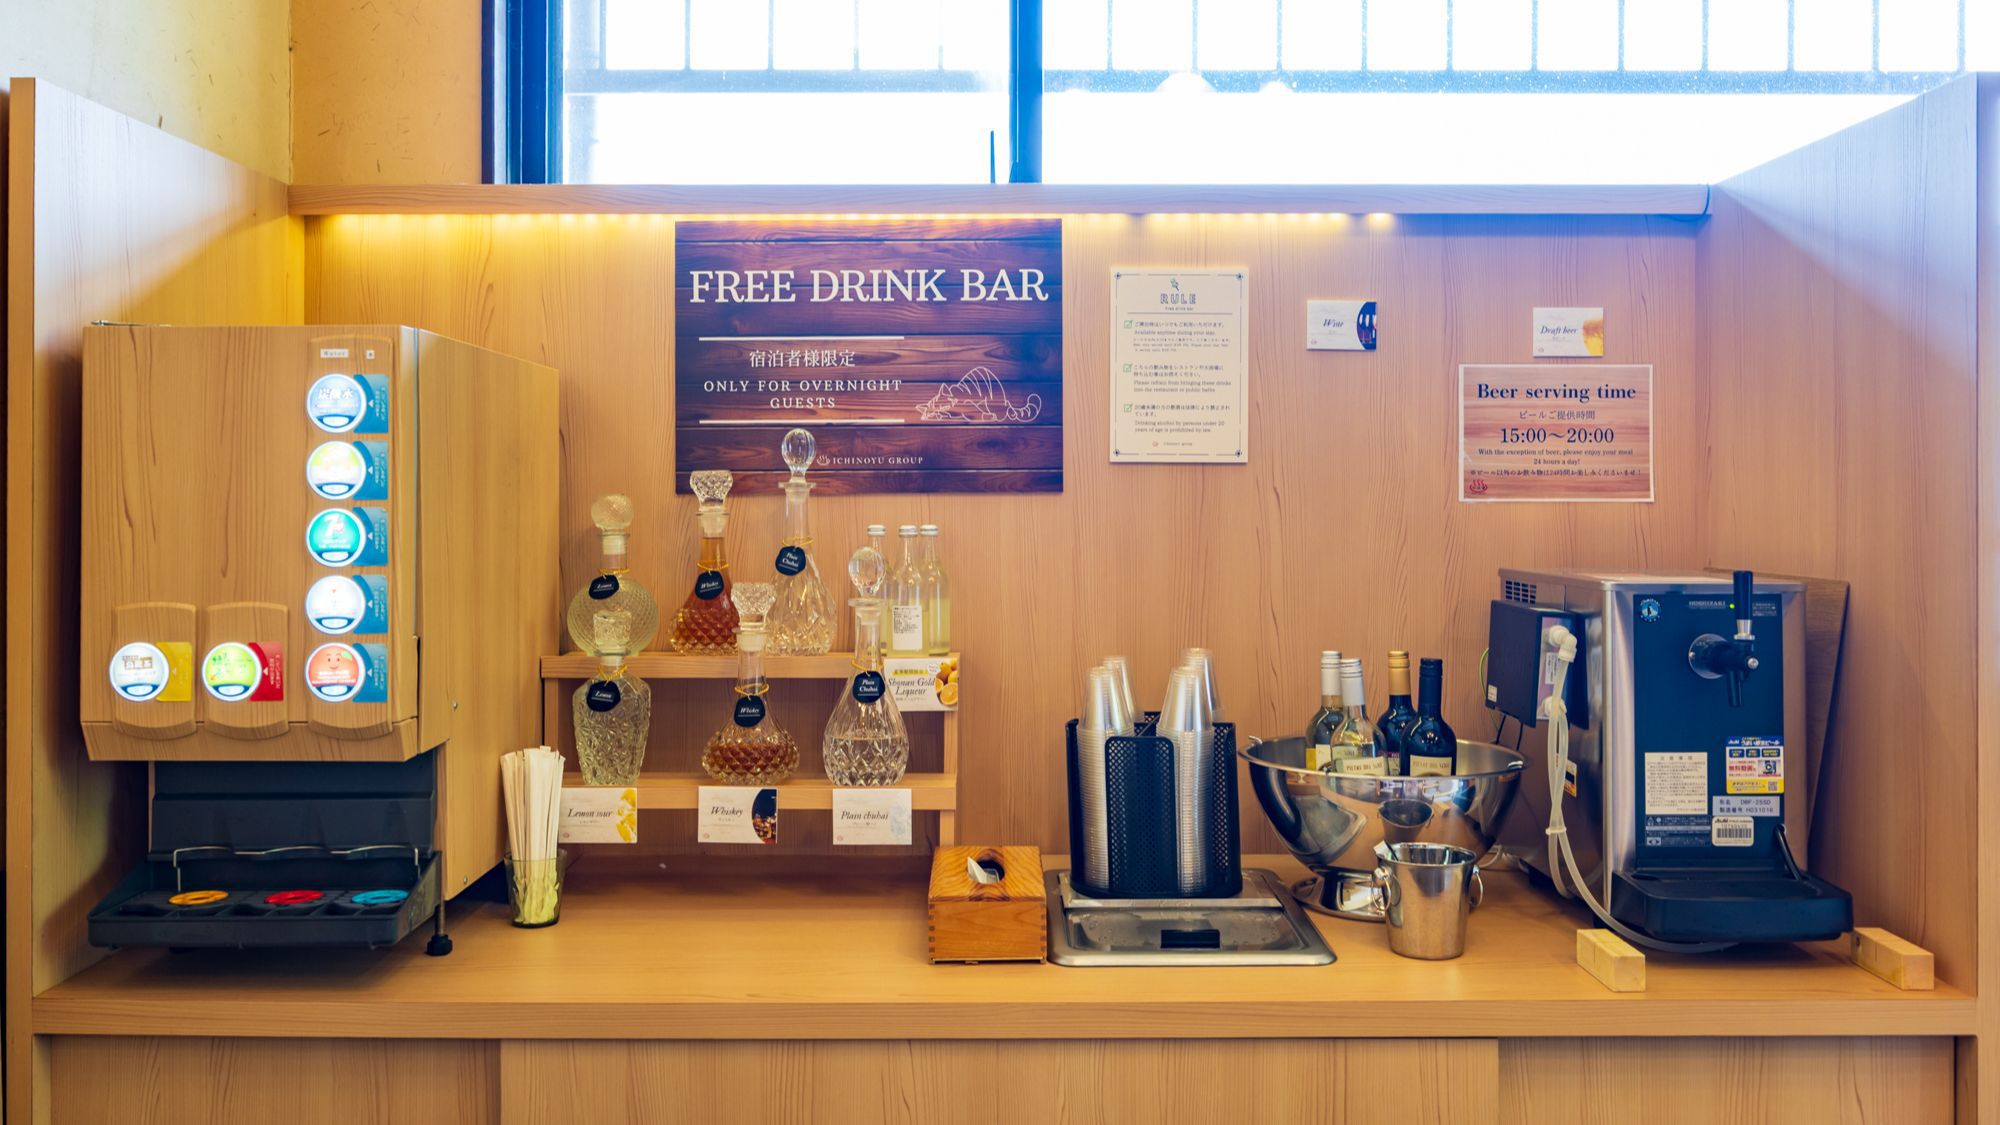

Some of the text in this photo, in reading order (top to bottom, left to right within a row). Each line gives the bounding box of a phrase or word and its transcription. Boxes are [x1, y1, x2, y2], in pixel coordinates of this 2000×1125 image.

[689, 268, 1049, 303] FREE DRINK BAR
[1160, 293, 1197, 304] RULE
[1323, 319, 1344, 327] Wine
[1540, 325, 1577, 336] Draft beer
[749, 349, 856, 368] 宿泊者様限定
[703, 379, 902, 393] ONLY FOR OVERNIGHT
[1477, 383, 1636, 403] Beer serving time
[770, 397, 836, 409] GUESTS
[1519, 410, 1596, 421] ビールご提供時間
[1478, 448, 1493, 456] With
[1494, 448, 1505, 456] the
[1506, 449, 1536, 457] exception
[1537, 448, 1544, 456] of
[1545, 448, 1561, 457] beer,
[1563, 448, 1583, 457] please
[1584, 449, 1601, 457] enjoy
[1618, 448, 1633, 456] meal
[832, 456, 923, 465] ICHINOYU GROUP
[1567, 458, 1580, 467] day!
[888, 677, 936, 687] Shonan Gold
[895, 686, 927, 697] Liqueur
[568, 808, 613, 818] Lemon sour
[710, 806, 744, 818] Whiskey
[840, 810, 889, 820] Plain chuhai
